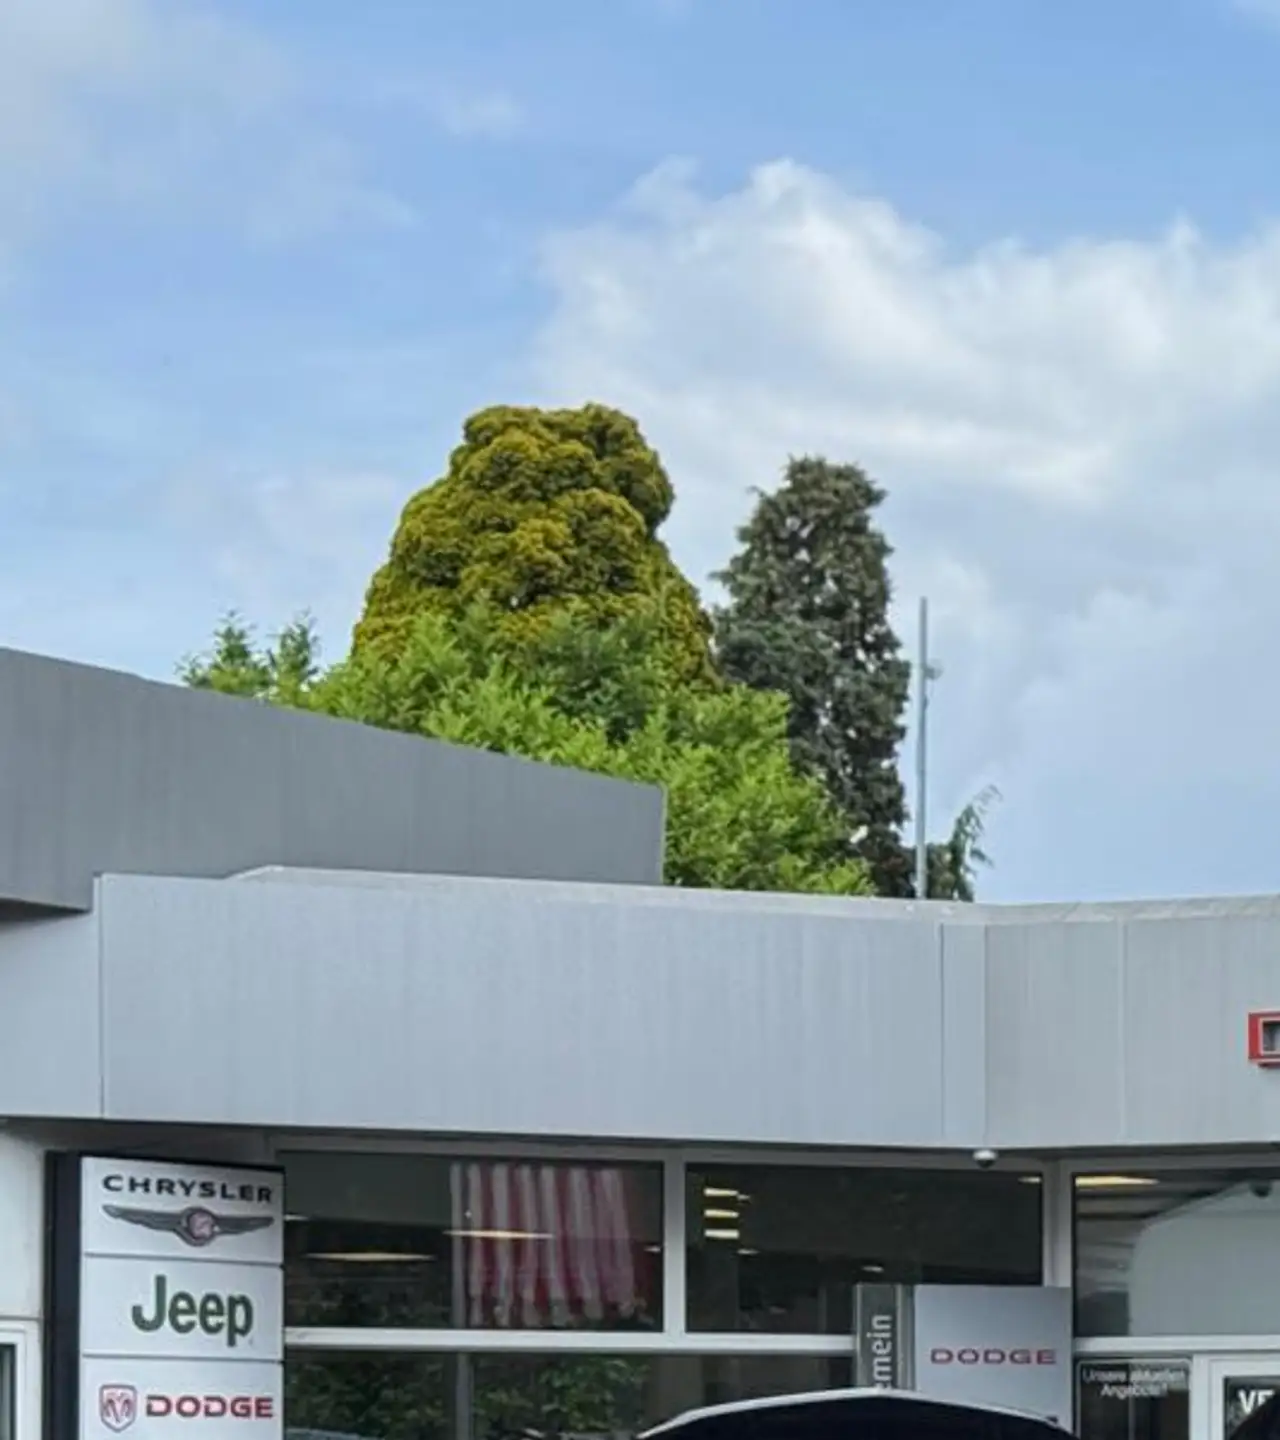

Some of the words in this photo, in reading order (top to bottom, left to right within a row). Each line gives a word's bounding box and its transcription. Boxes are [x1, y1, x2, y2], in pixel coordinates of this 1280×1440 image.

[102, 1174, 272, 1203] CHRYSLER
[132, 1275, 253, 1347] Jeep
[930, 1348, 1057, 1365] DODGE
[145, 1396, 273, 1418] DODGE
